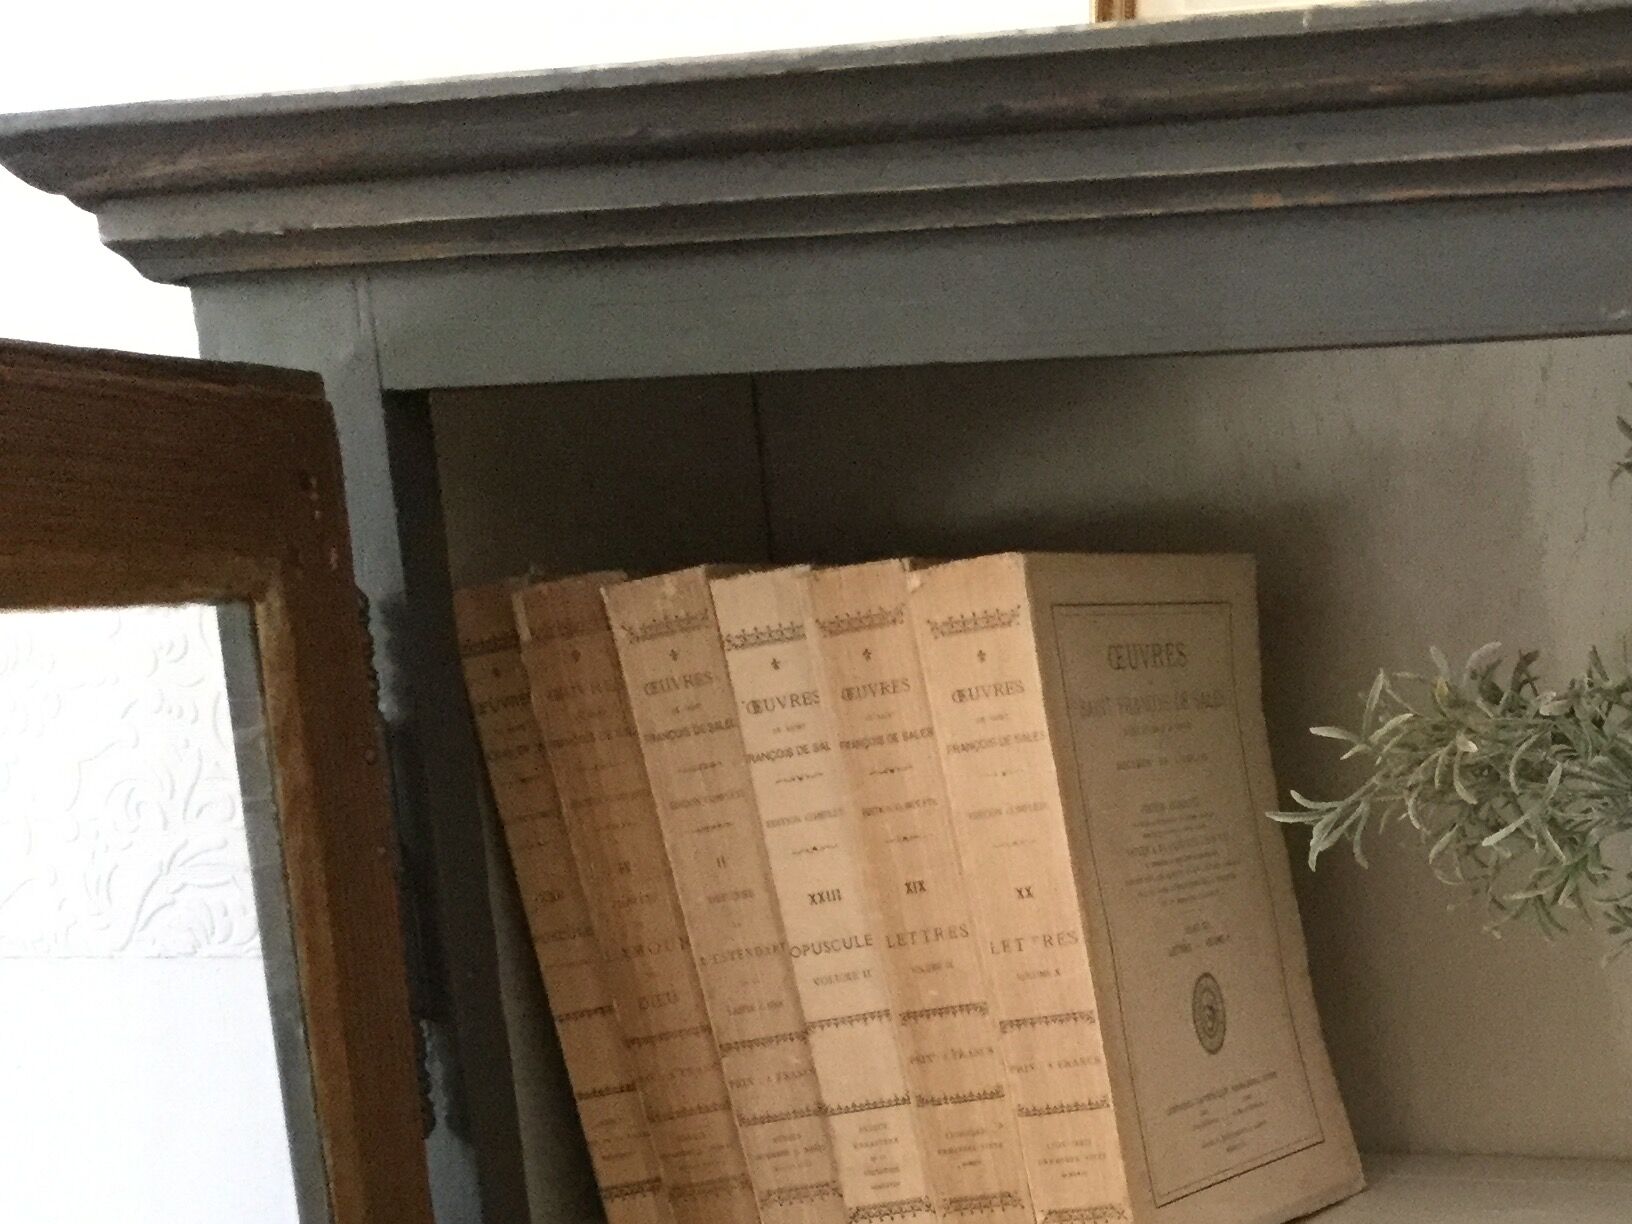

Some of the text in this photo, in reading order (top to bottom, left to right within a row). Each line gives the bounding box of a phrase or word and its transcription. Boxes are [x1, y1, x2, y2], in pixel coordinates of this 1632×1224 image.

[746, 690, 821, 715] ŒUVRES
[951, 680, 1026, 704] ŒUVRES
[796, 744, 810, 757] DE
[807, 888, 843, 907] XXIII
[904, 879, 928, 896] XIX
[1014, 885, 1035, 901] XX
[789, 933, 874, 960] OPUSCULE
[885, 922, 970, 950] LETTRES
